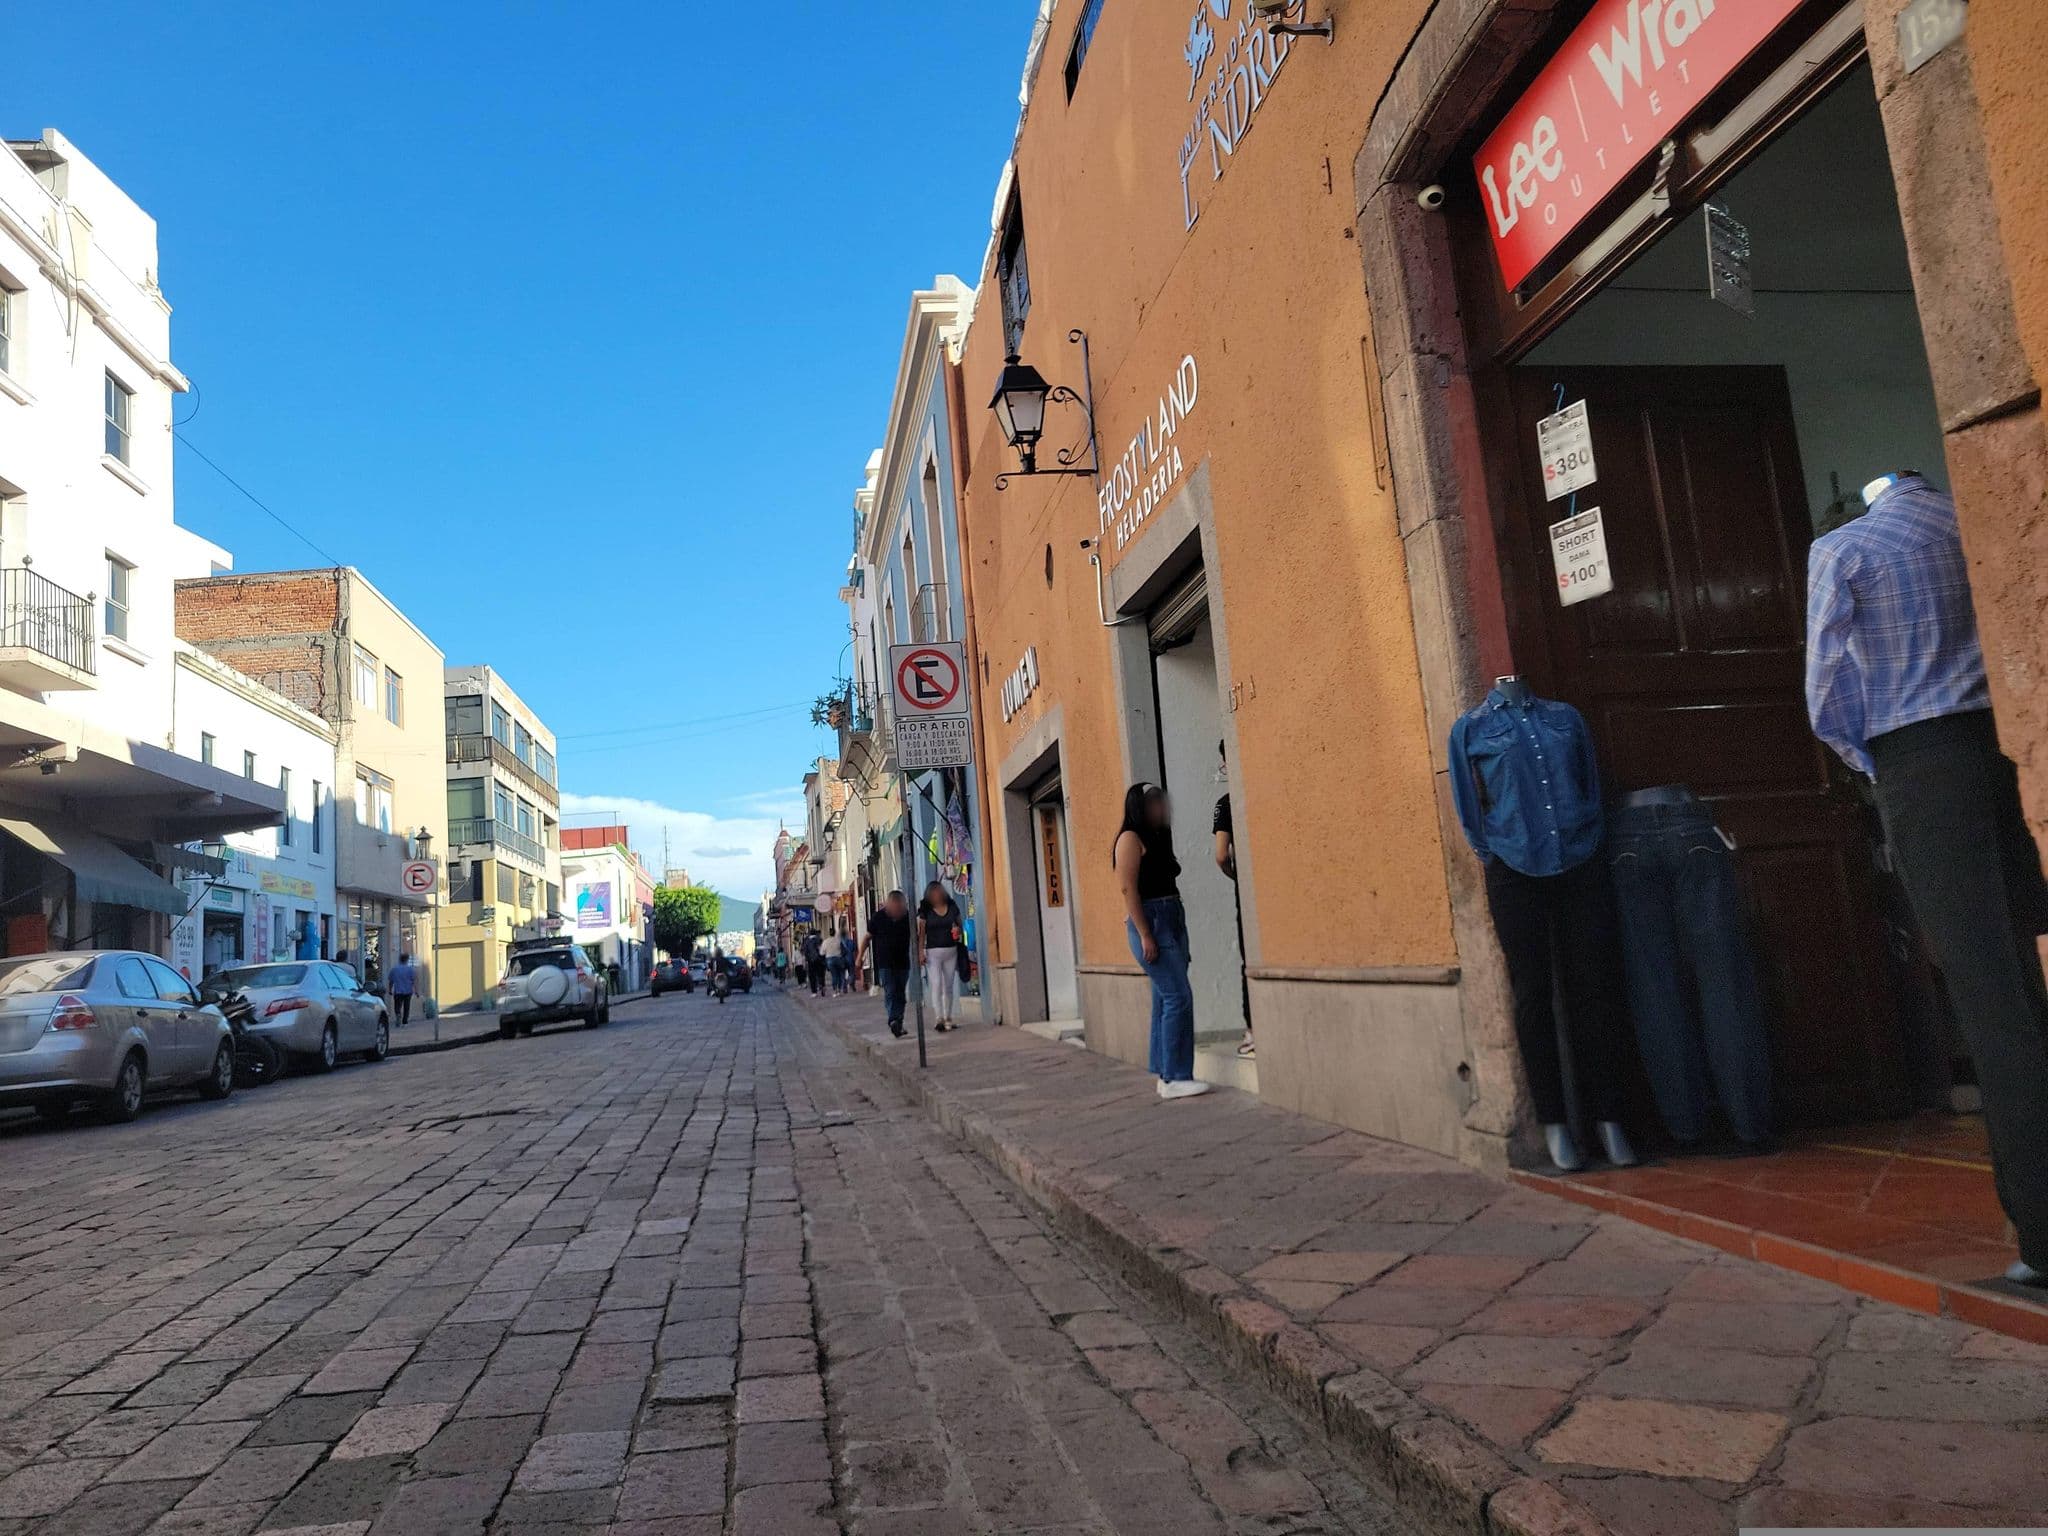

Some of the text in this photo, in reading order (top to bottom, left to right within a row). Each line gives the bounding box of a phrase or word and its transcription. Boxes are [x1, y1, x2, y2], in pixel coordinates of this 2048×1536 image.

[1544, 58, 1690, 225] OUTLET
[1482, 115, 1563, 238] Lee
[1100, 354, 1198, 535] FROSTYLAND
[1544, 447, 1590, 481] $380
[1117, 445, 1184, 551] HELADERÍA
[1559, 529, 1597, 552] SHORT
[1568, 548, 1591, 562] DAMA
[1001, 646, 1038, 723] LUMEN
[899, 720, 965, 732] HORARIO
[900, 732, 921, 741] CARGA
[932, 730, 966, 739] DESCARGA
